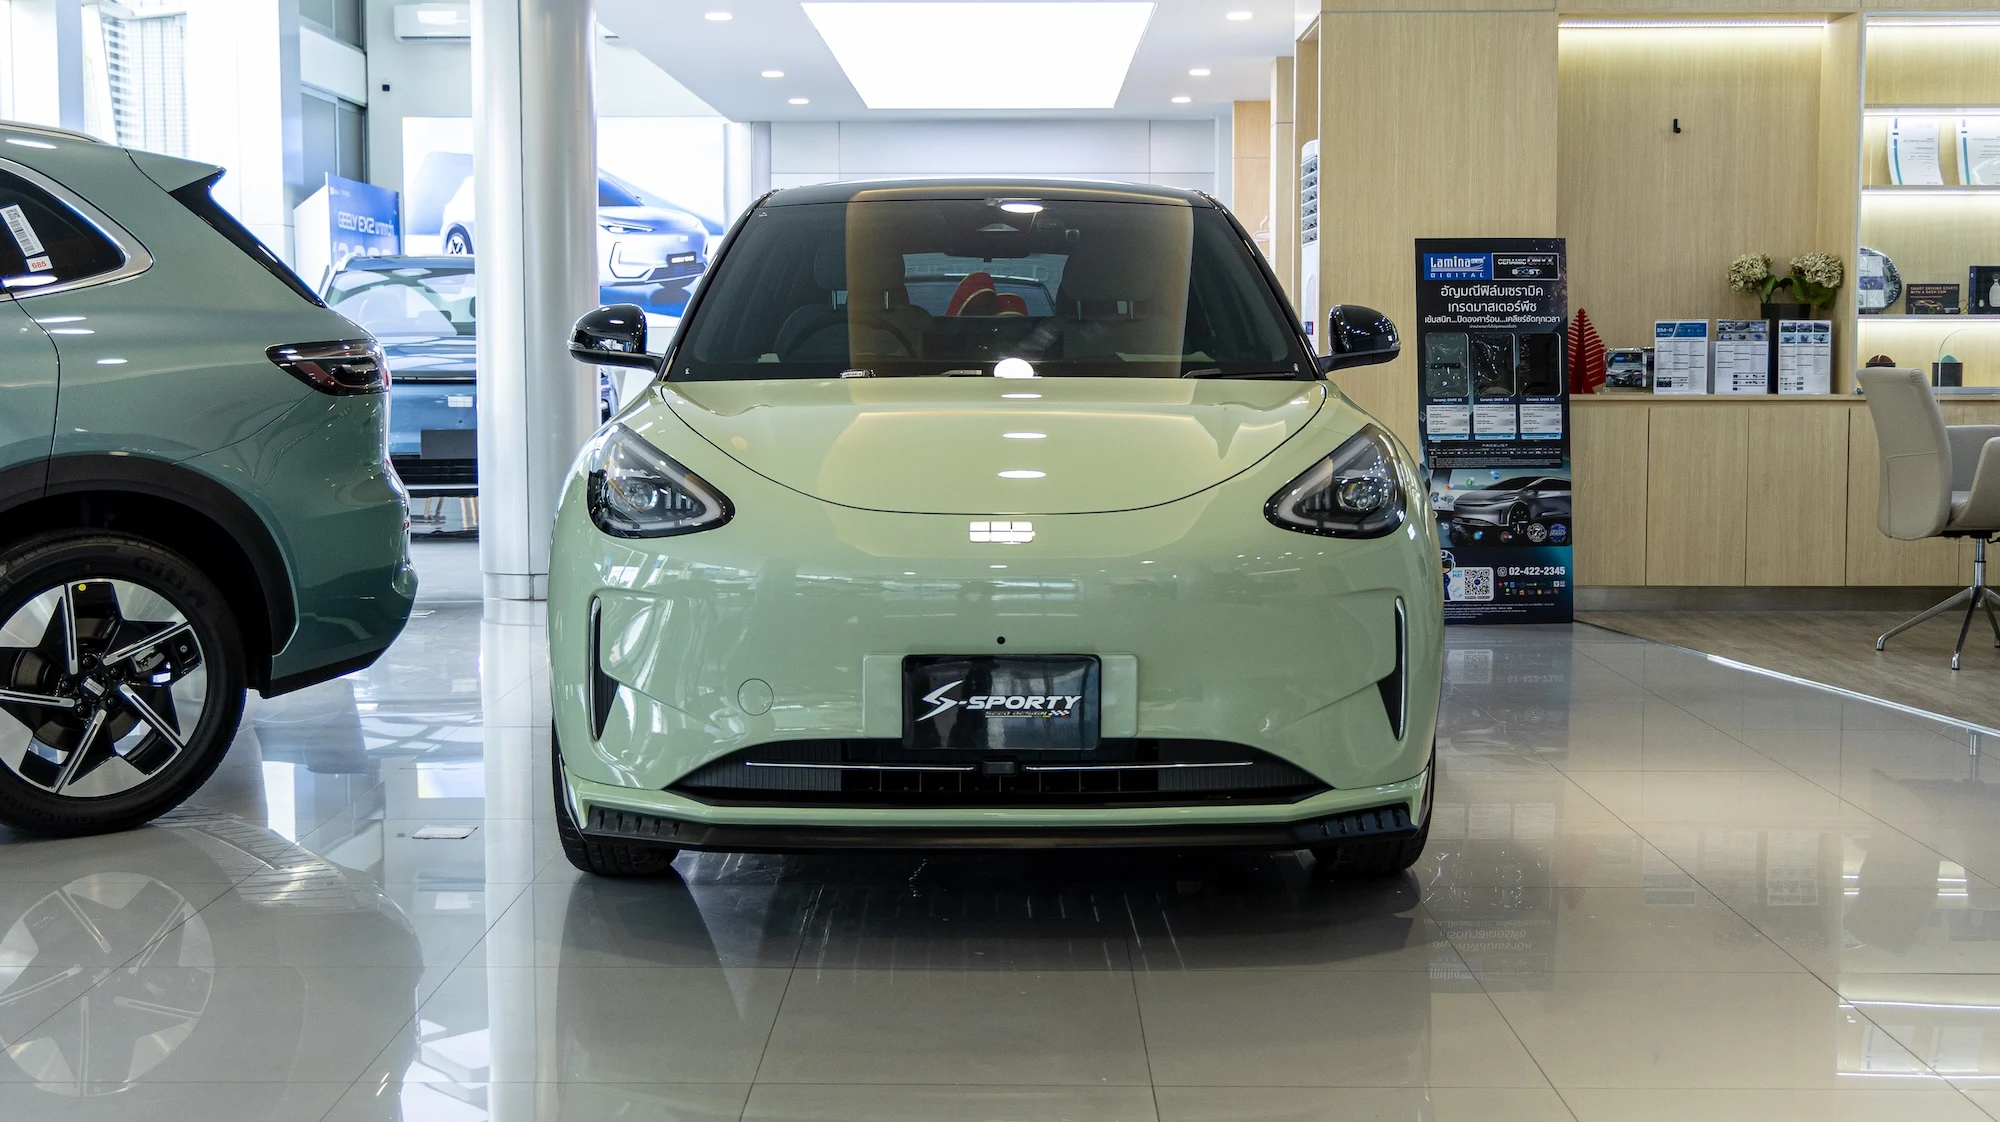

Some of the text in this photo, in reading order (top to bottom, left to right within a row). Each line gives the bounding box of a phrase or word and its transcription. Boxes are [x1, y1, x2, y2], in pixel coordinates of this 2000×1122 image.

[358, 215, 375, 234] EX2
[31, 261, 47, 269] 685
[1431, 256, 1470, 267] Lamina
[1508, 566, 1566, 576] 02-422-2345
